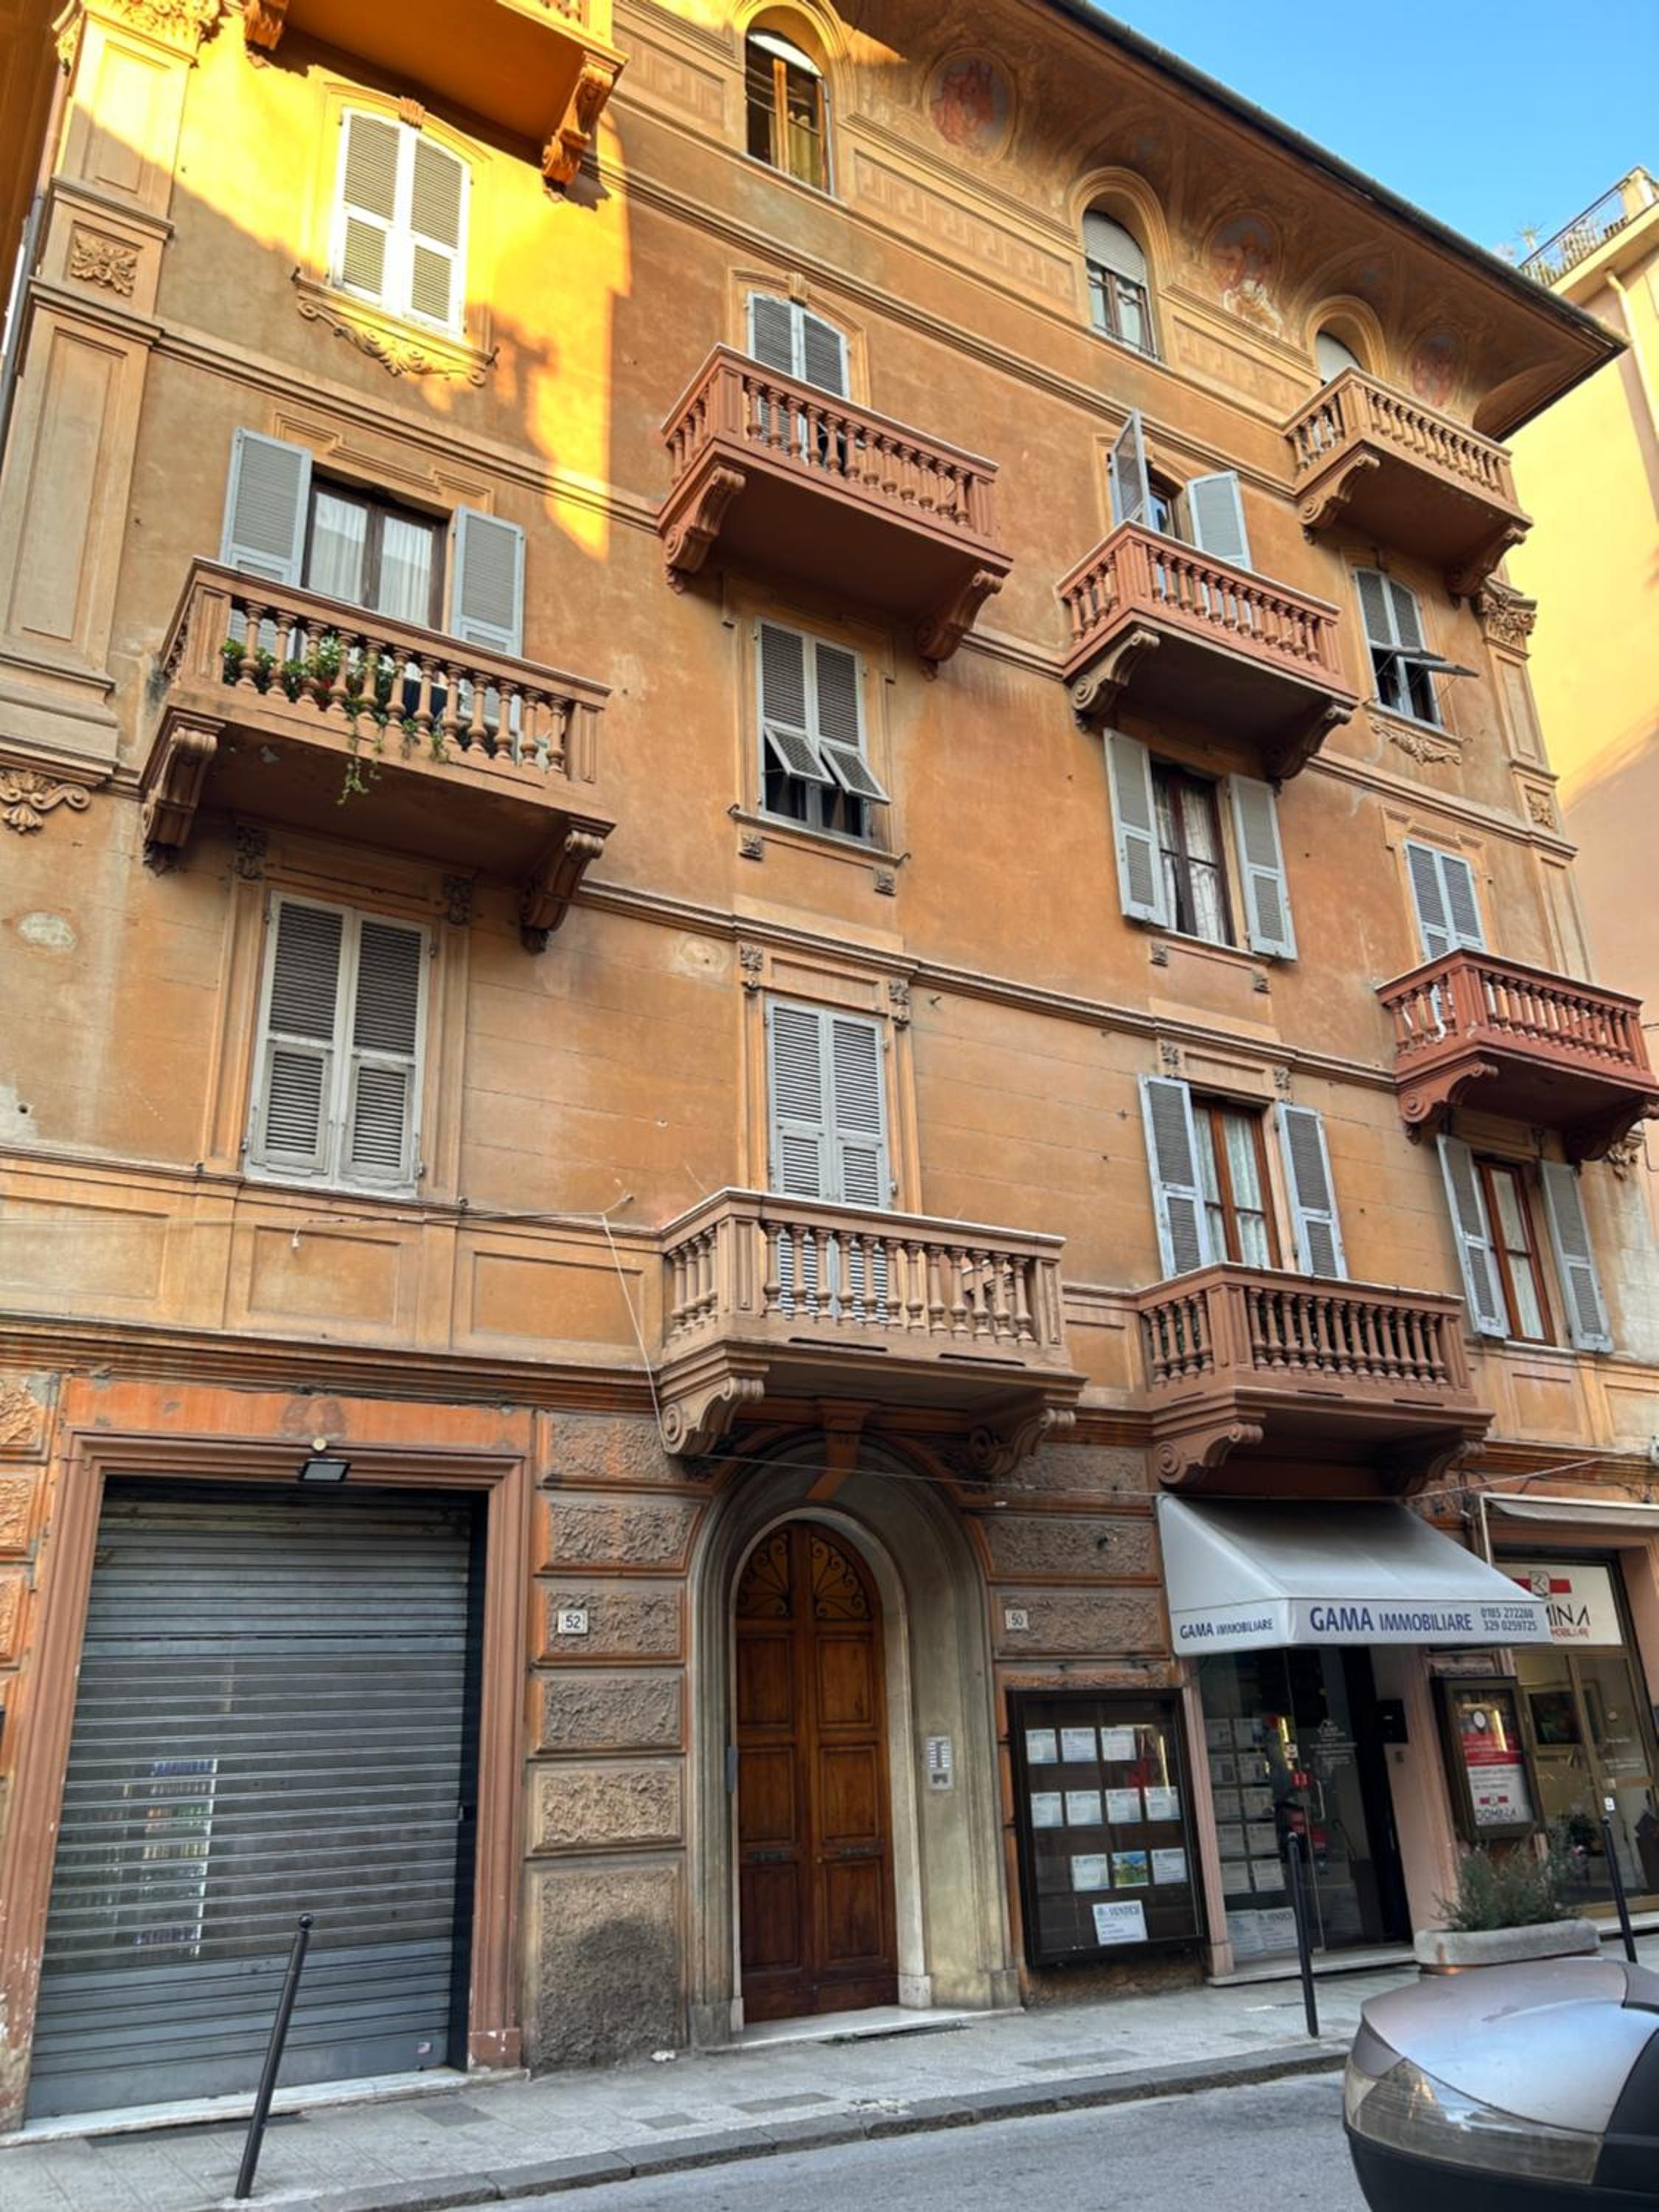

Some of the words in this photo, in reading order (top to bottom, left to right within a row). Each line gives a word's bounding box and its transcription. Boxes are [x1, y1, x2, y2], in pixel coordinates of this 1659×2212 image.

[566, 1615, 581, 1628] 52
[1180, 1622, 1214, 1639] GAMA
[1217, 1618, 1274, 1635] IMMOBILIARE
[1310, 1607, 1374, 1632] GAMA
[1380, 1613, 1472, 1632] IMMOBILIARE
